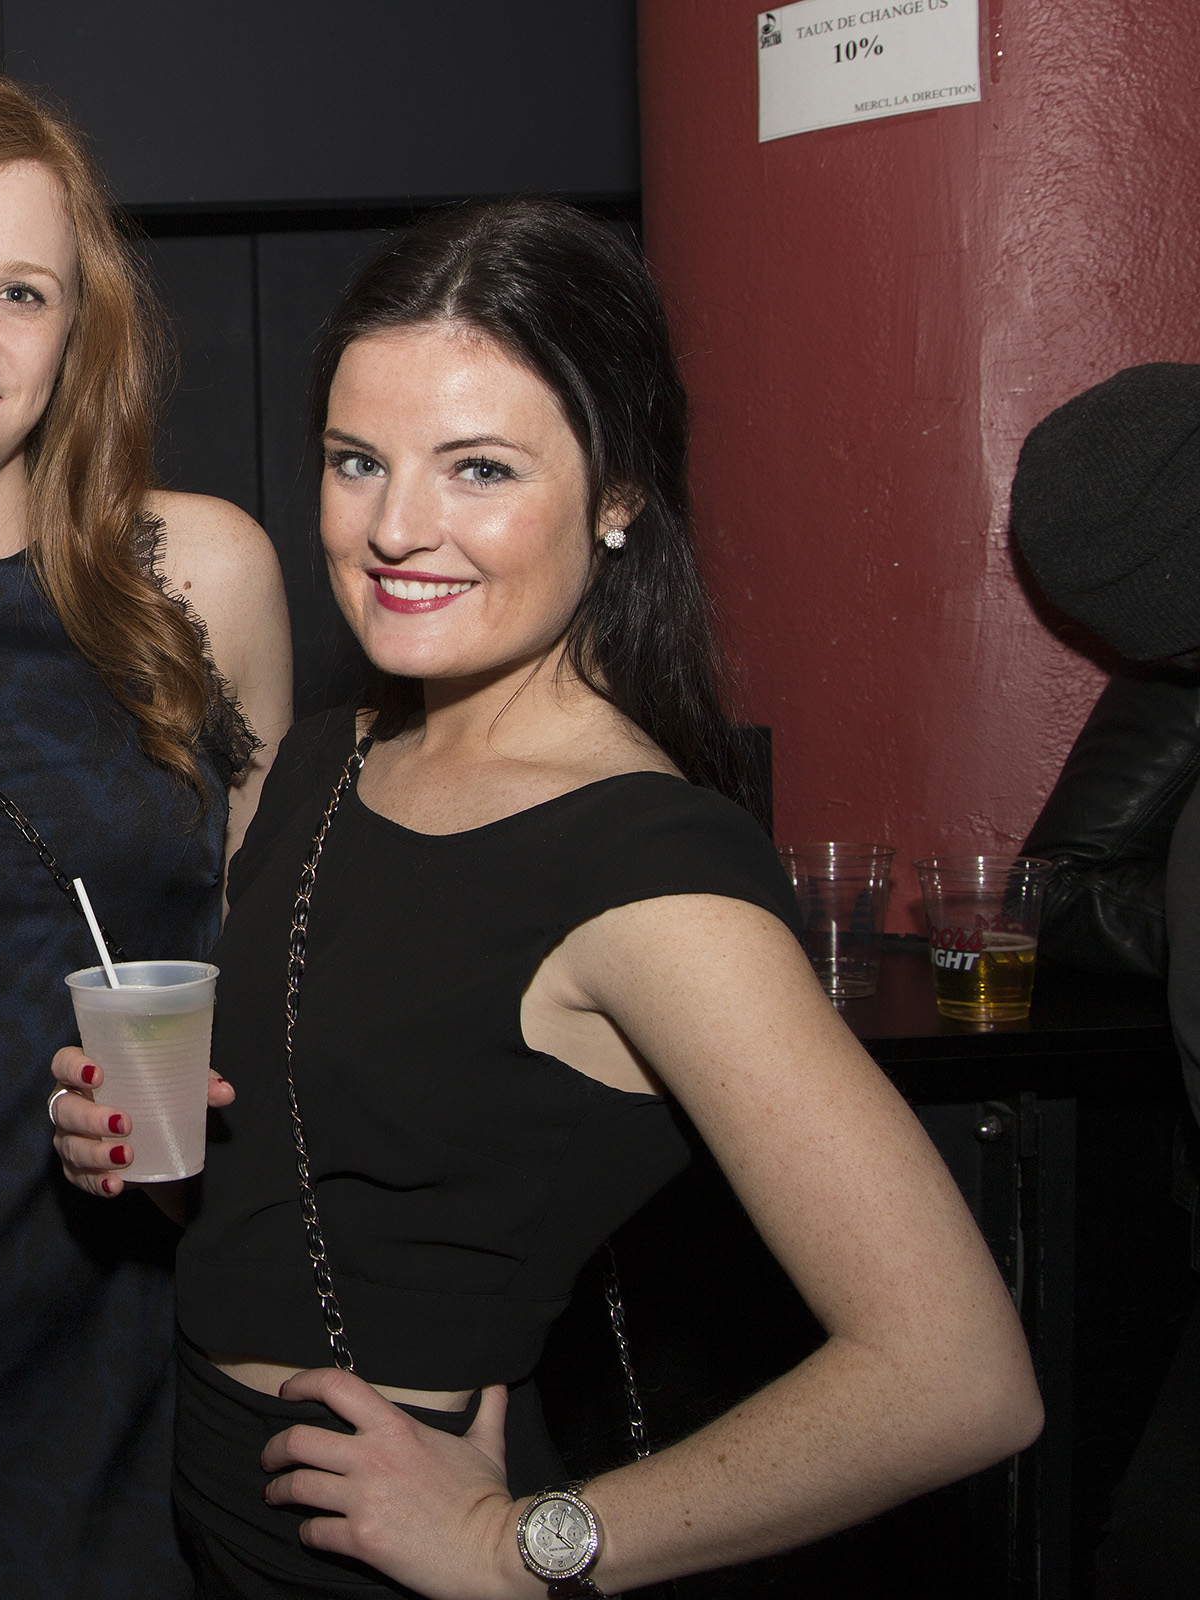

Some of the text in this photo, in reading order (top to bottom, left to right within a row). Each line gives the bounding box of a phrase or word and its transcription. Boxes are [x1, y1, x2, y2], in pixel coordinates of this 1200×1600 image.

[796, 0, 949, 39] TAUX DE CHANGE US
[833, 34, 884, 64] 10%
[894, 95, 909, 106] LA
[912, 84, 977, 102] DIRECTION
[931, 948, 980, 971] IGHT
